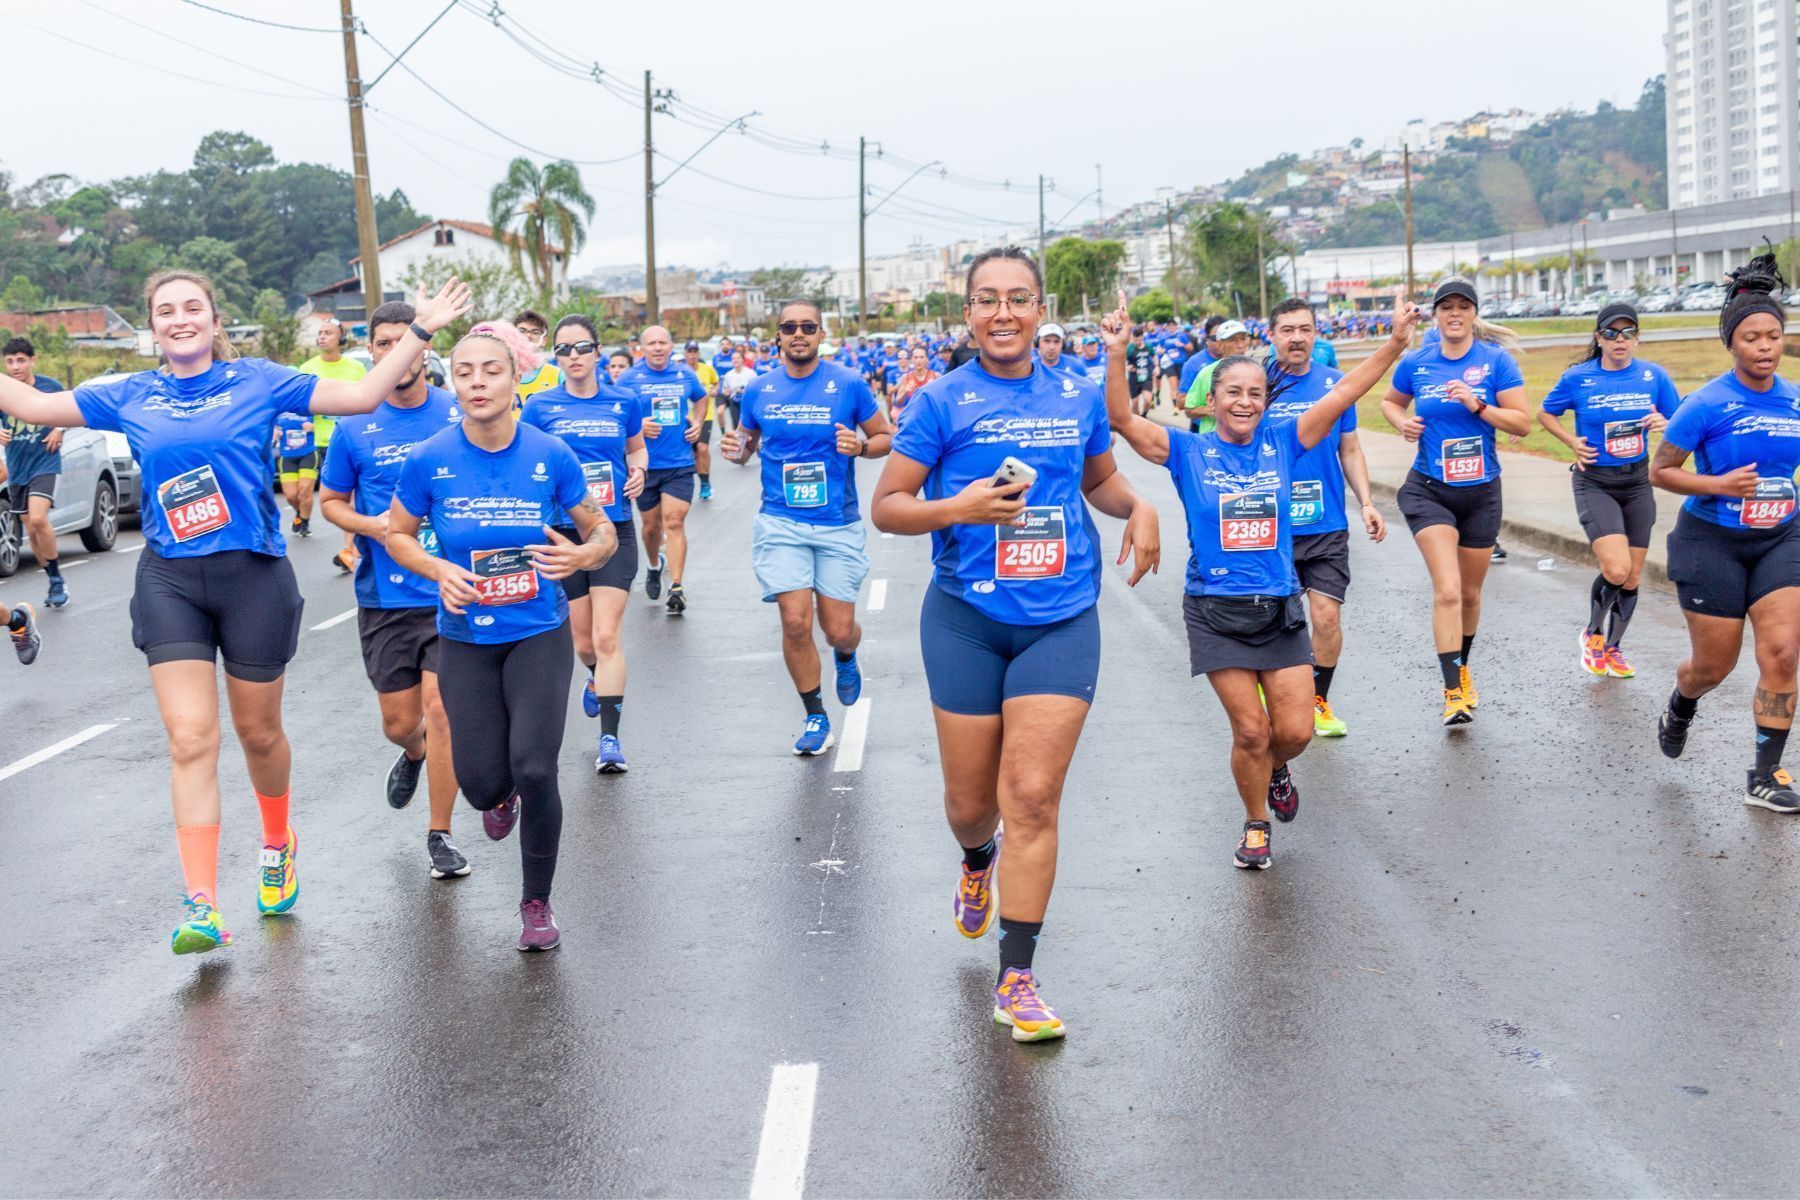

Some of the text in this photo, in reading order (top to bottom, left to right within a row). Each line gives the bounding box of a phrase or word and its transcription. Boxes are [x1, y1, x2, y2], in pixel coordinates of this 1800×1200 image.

[1006, 417, 1079, 430] Camilo dos Santos
[1610, 437, 1639, 452] 1969
[1448, 458, 1480, 475] 1537
[792, 484, 818, 499] 795
[515, 499, 542, 509] Santos
[1747, 502, 1788, 519] 1841
[174, 498, 220, 530] 1486
[1227, 521, 1271, 540] 2386
[1003, 542, 1059, 566] 2505
[482, 574, 531, 597] 1356
